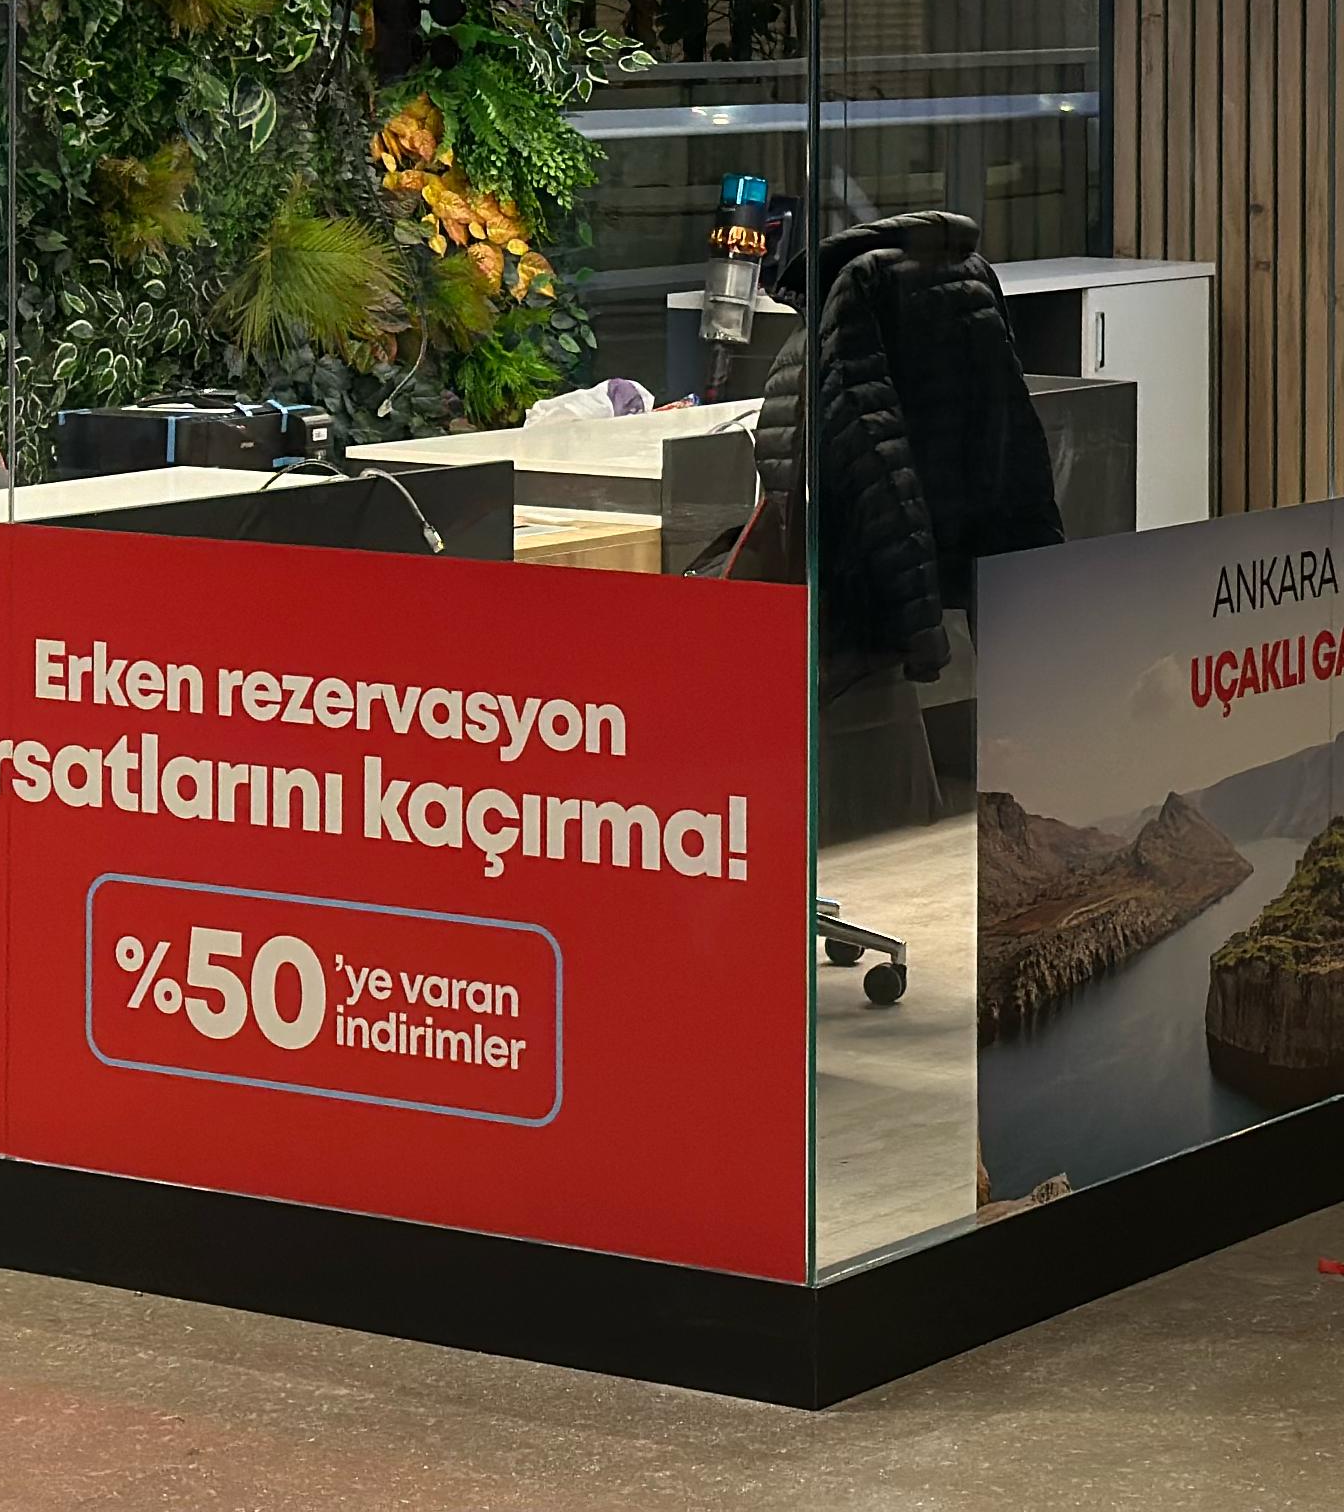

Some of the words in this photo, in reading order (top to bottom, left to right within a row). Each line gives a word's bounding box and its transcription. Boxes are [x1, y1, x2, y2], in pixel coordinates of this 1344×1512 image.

[1212, 546, 1339, 618] ANKARA
[35, 638, 204, 714] Erken
[218, 667, 627, 763] rezervasyon
[1190, 637, 1305, 718] UÇAKLI
[363, 755, 748, 882] kaçırma!
[114, 926, 327, 1050] %50
[399, 969, 520, 1018] varan
[335, 1004, 527, 1072] indirimler
